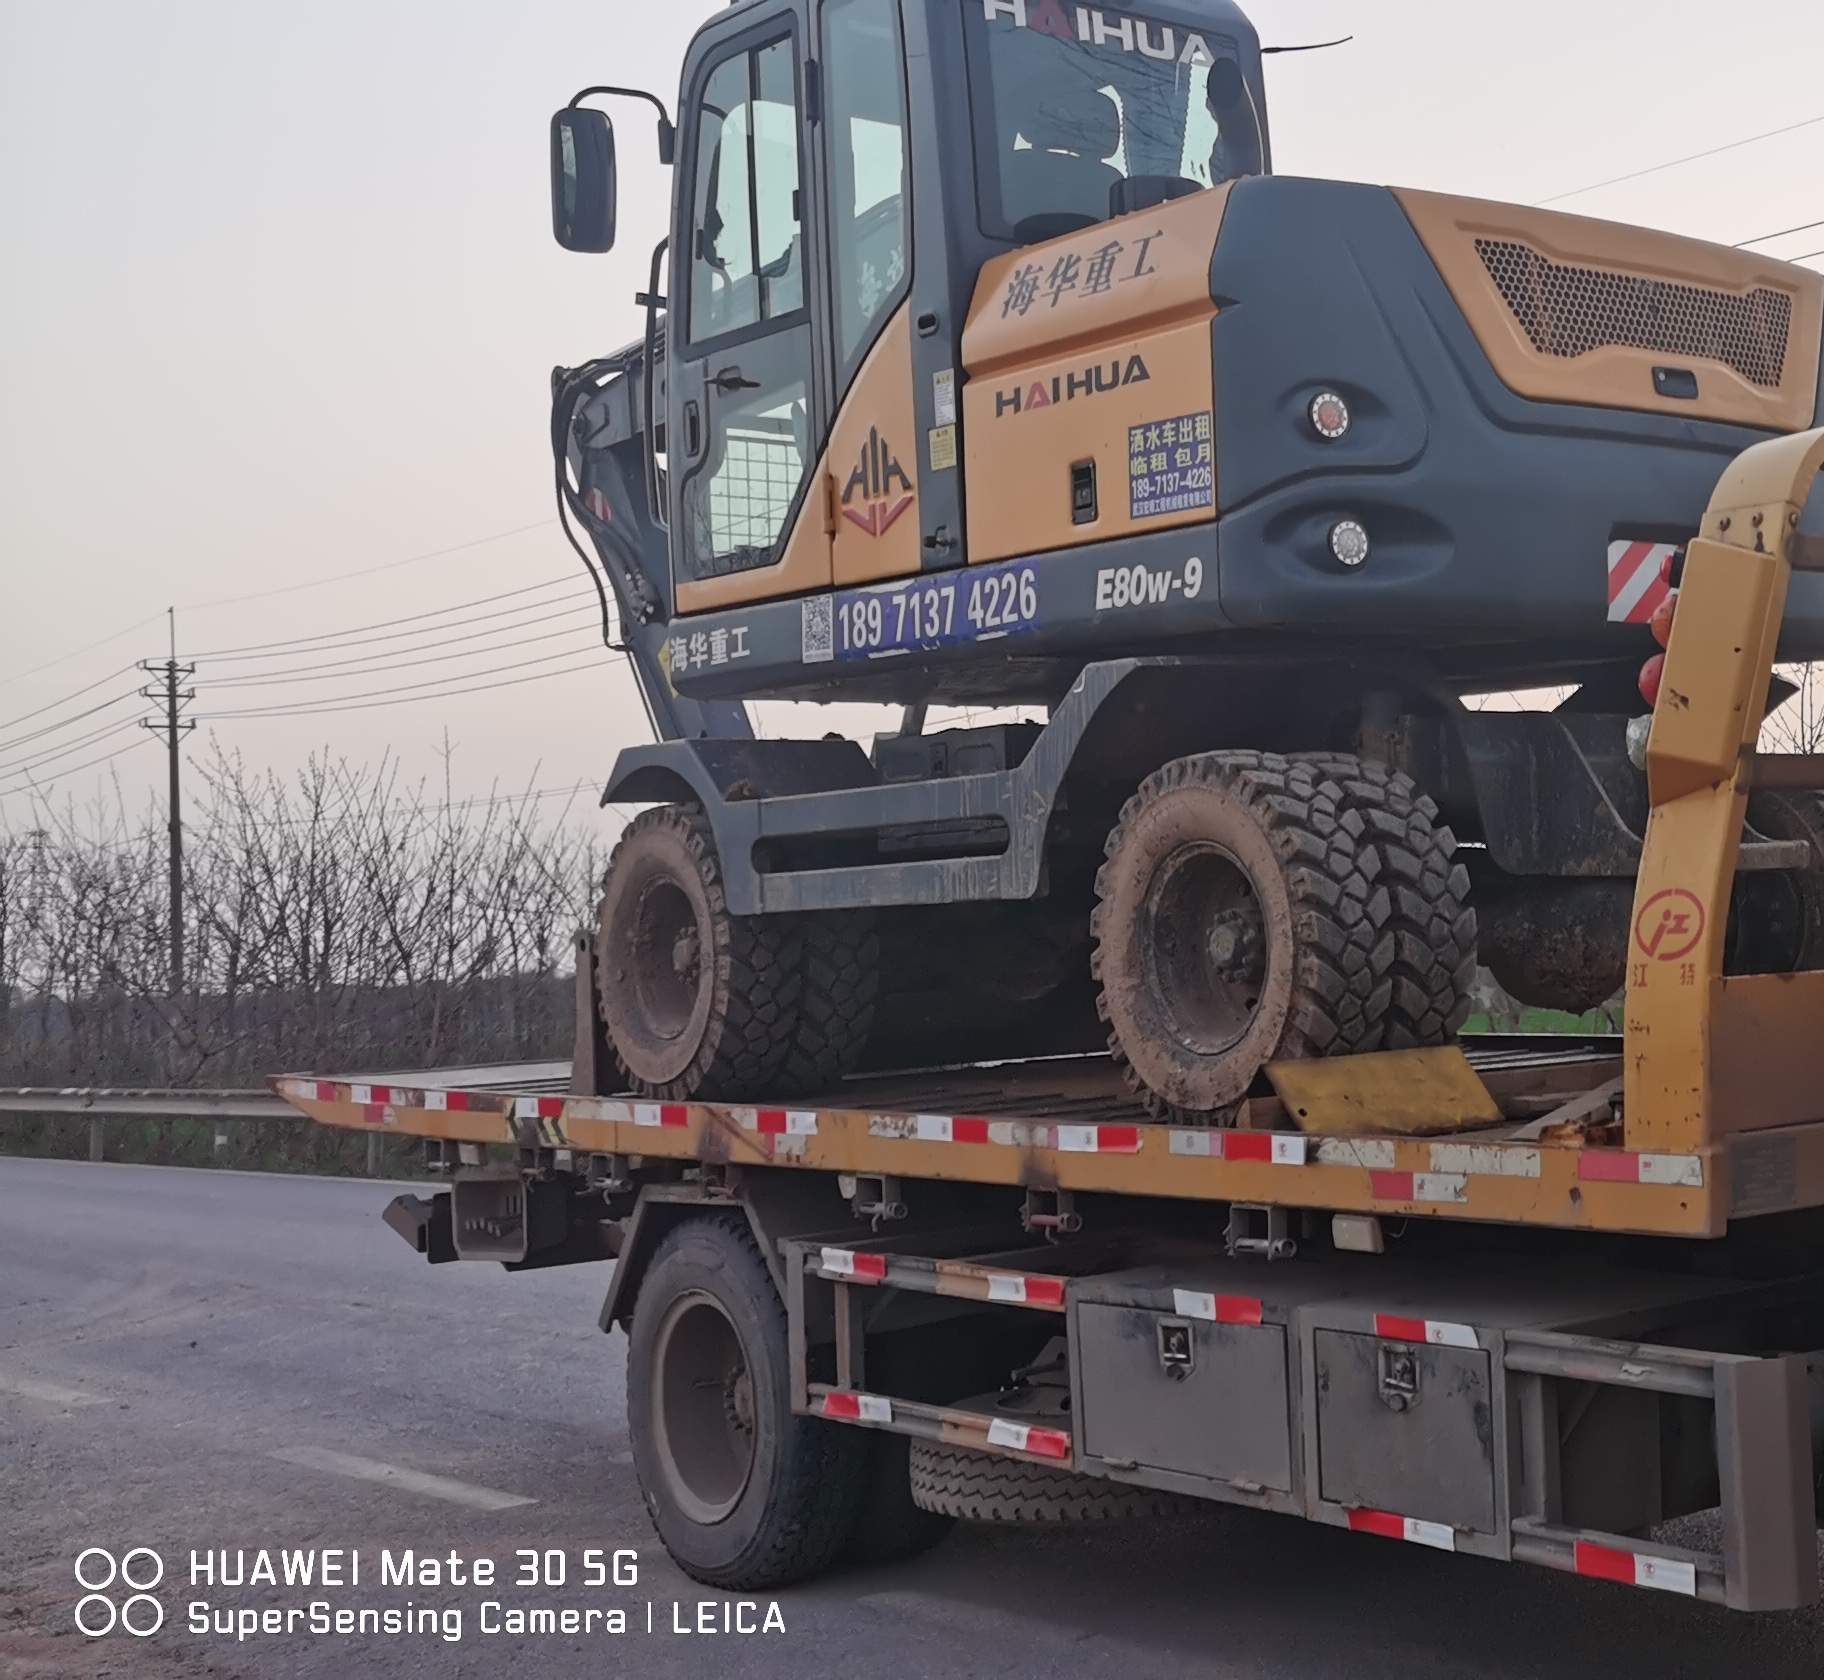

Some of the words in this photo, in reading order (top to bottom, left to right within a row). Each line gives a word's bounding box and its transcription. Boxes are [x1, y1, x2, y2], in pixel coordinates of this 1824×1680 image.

[984, 0, 1216, 67] HAIHUA
[1001, 229, 1164, 319] 海华重工
[994, 354, 1151, 418] HAIHUA
[1130, 415, 1211, 454] 洒水车出租
[1131, 465, 1212, 499] 189-7137-4226
[838, 597, 883, 650] 189
[890, 586, 956, 641] 7137
[966, 568, 1038, 629] 4226
[670, 626, 751, 672] 海华重工
